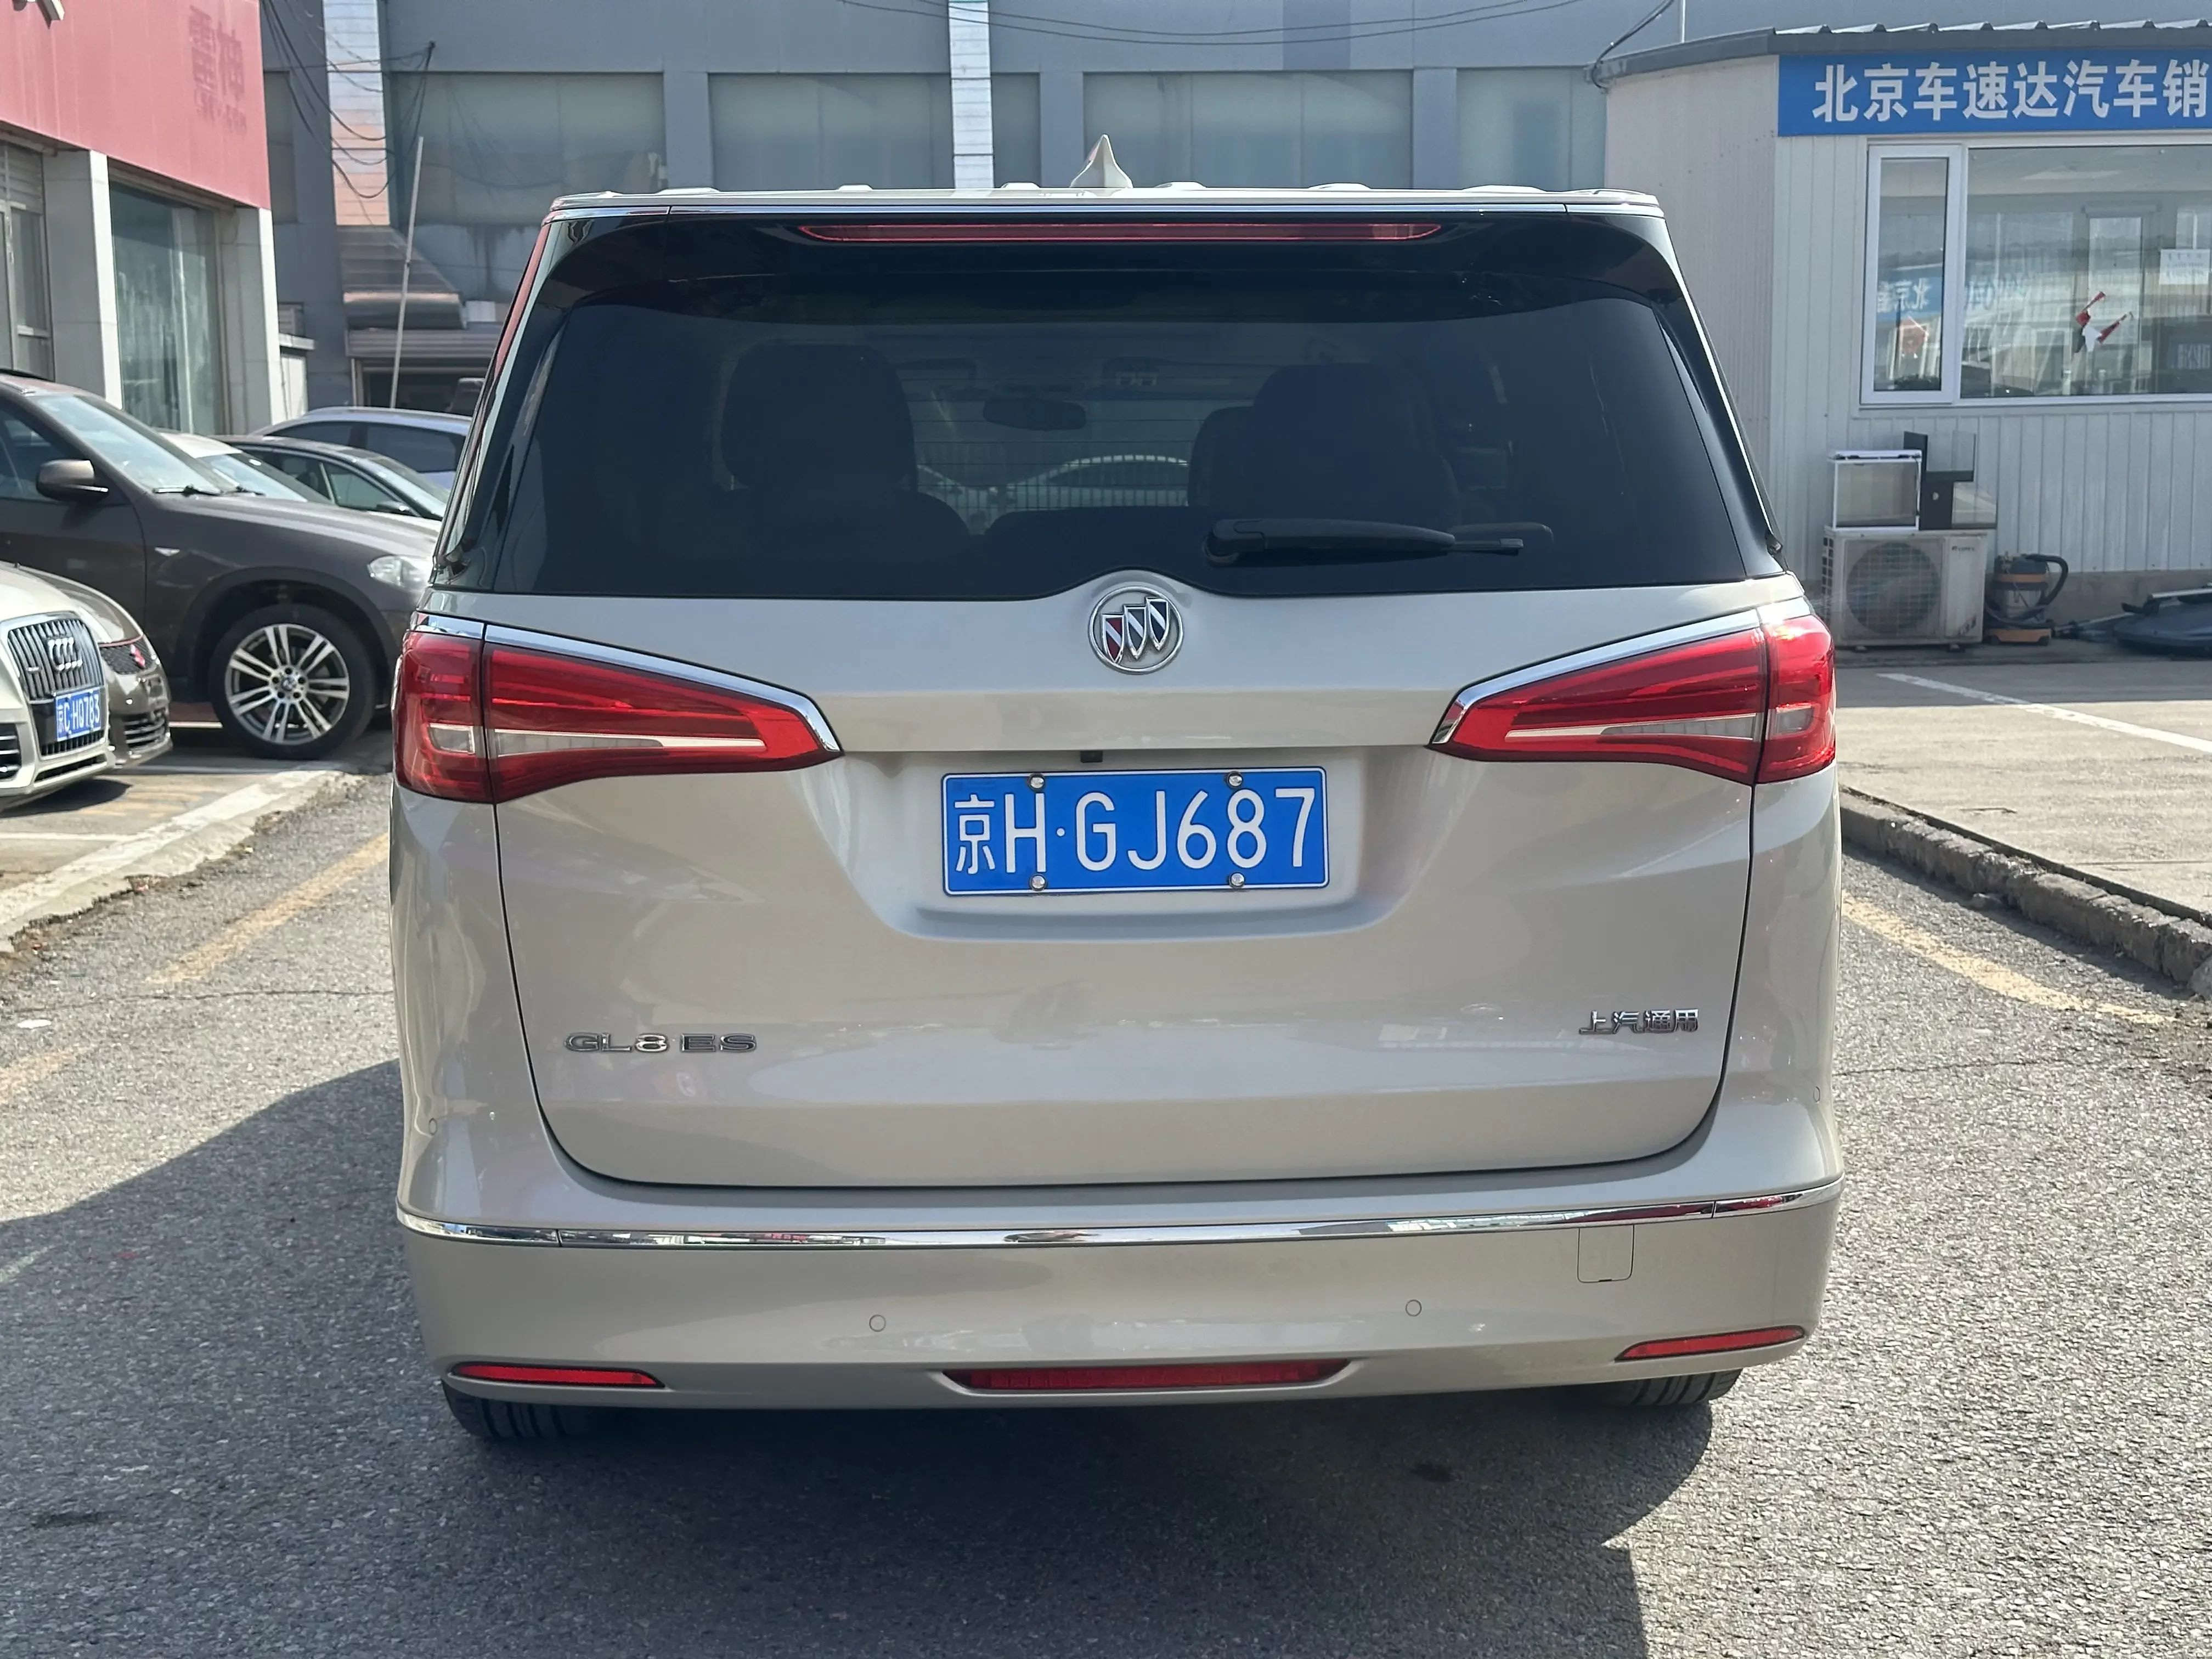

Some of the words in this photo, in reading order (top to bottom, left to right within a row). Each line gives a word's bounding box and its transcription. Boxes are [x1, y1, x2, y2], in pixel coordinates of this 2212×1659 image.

[1812, 59, 2210, 123] 北京车速达汽车销
[954, 787, 1316, 874] 京H·GJ687
[564, 1032, 669, 1052] GL8
[680, 1032, 757, 1052] ES
[1578, 1009, 1699, 1034] 上汽通用
